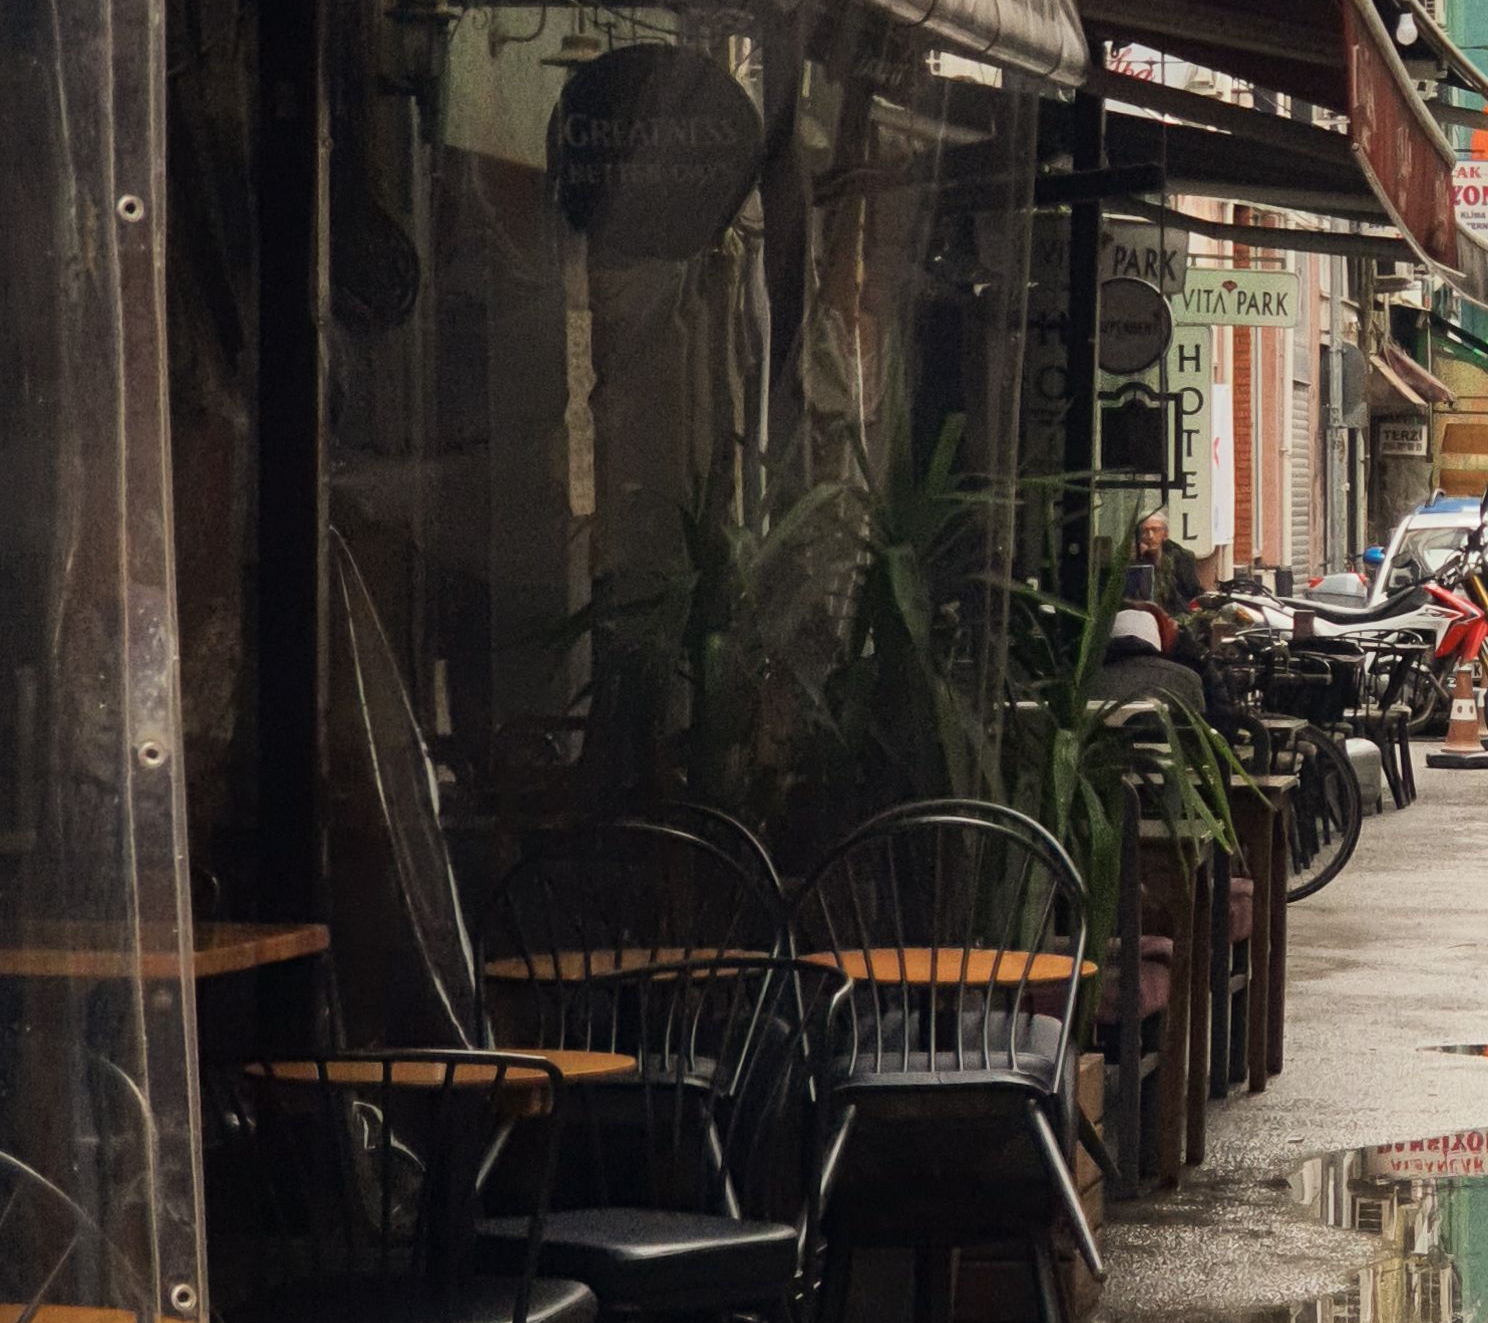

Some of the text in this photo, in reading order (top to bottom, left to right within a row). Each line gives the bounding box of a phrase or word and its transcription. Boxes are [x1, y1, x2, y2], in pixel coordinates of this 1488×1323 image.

[1453, 165, 1482, 179] AK
[1112, 247, 1177, 281] PARK
[1182, 287, 1289, 316] VITA PARK
[1177, 343, 1204, 541] HOTEL
